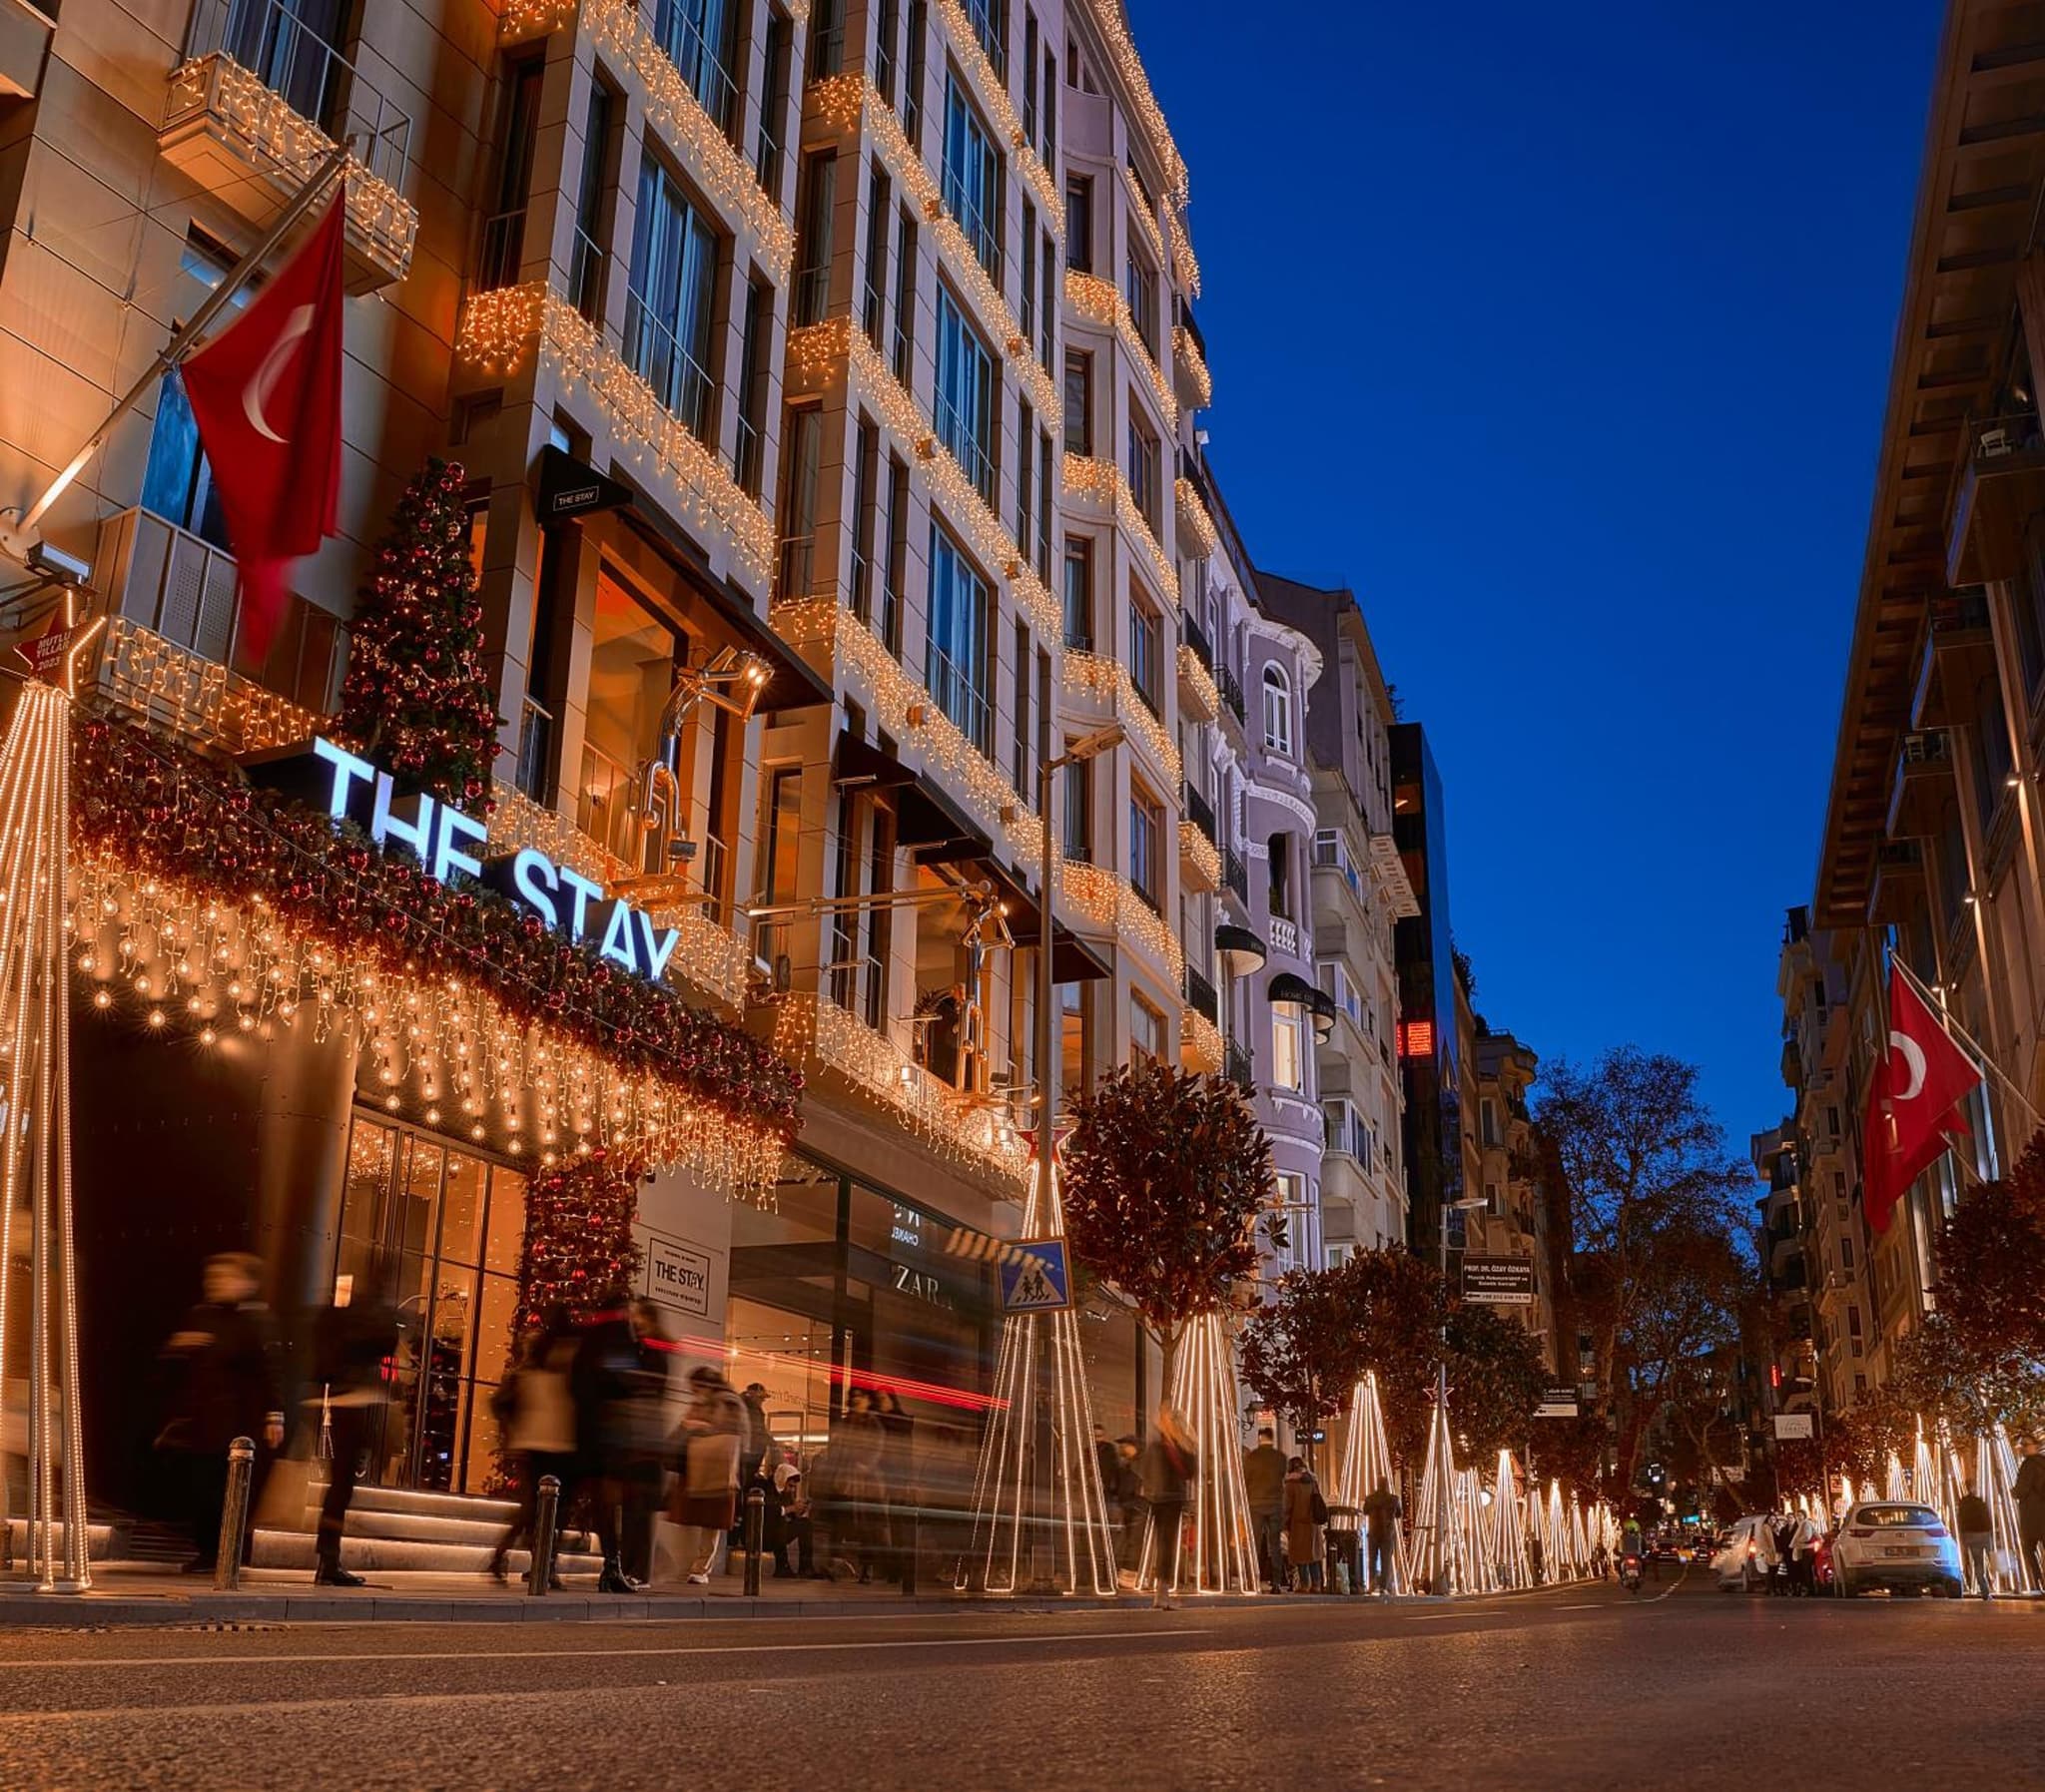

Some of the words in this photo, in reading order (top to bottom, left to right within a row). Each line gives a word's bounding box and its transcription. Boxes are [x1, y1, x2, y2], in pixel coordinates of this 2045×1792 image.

[559, 495, 574, 506] THE
[574, 491, 595, 503] STAY
[513, 848, 681, 981] STAY
[655, 1260, 677, 1283] THE
